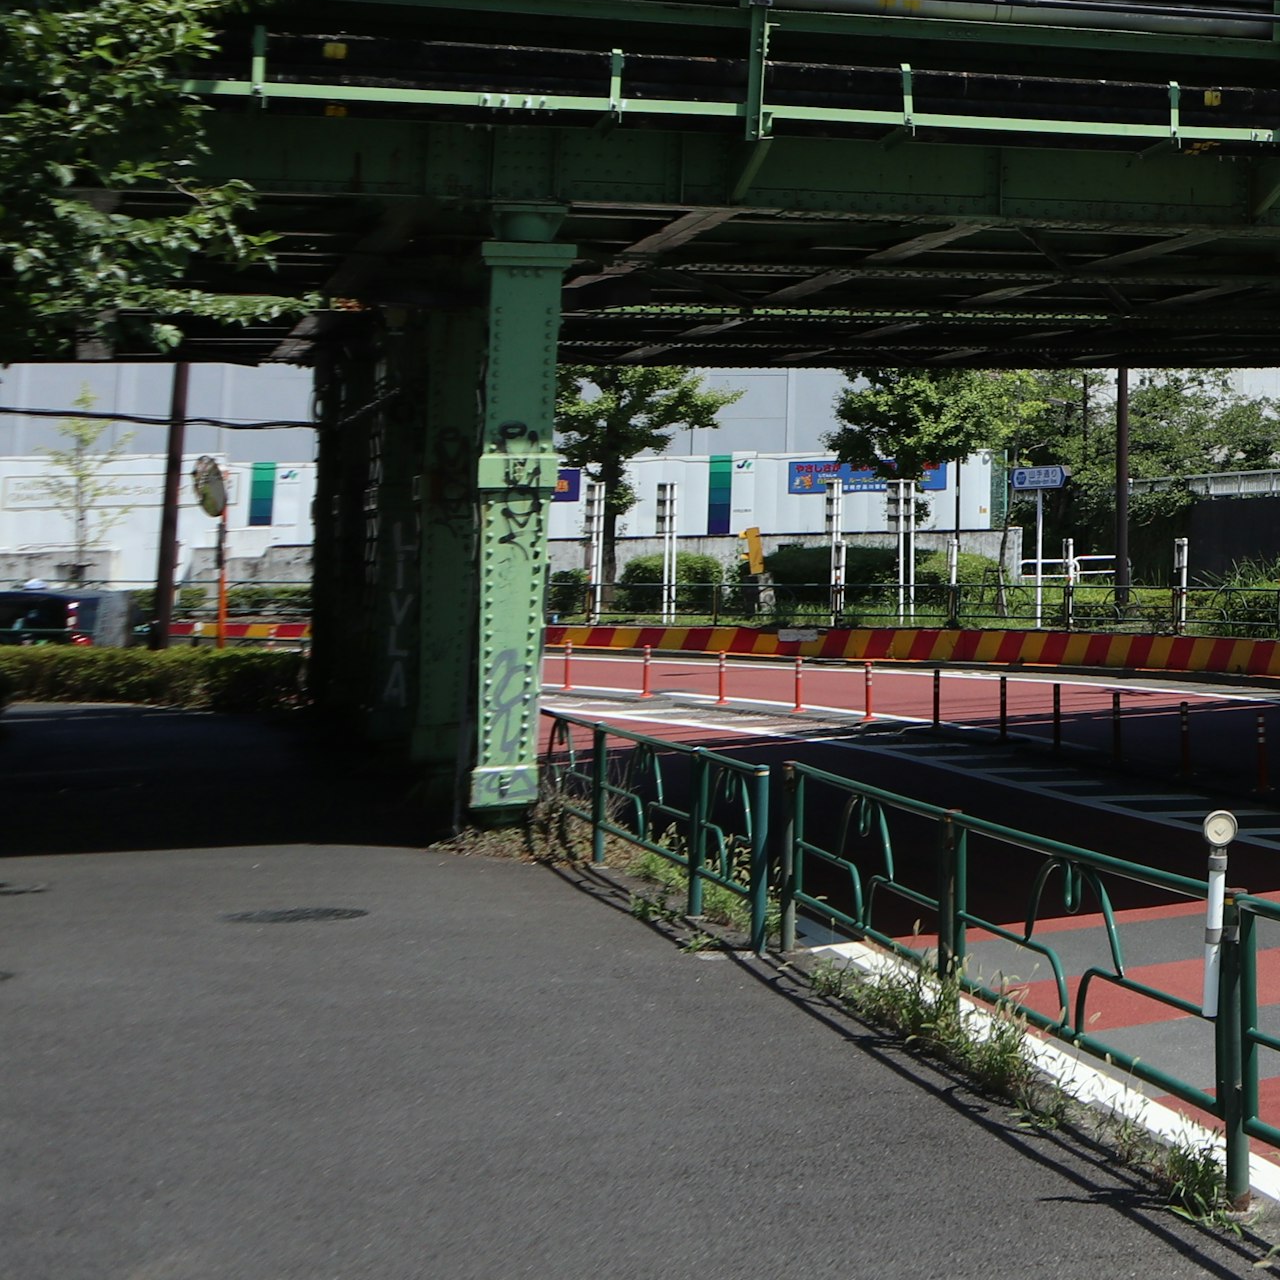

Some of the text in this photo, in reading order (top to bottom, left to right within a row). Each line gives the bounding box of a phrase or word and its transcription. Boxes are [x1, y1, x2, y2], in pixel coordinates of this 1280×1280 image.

[795, 463, 841, 473] やさしさが
